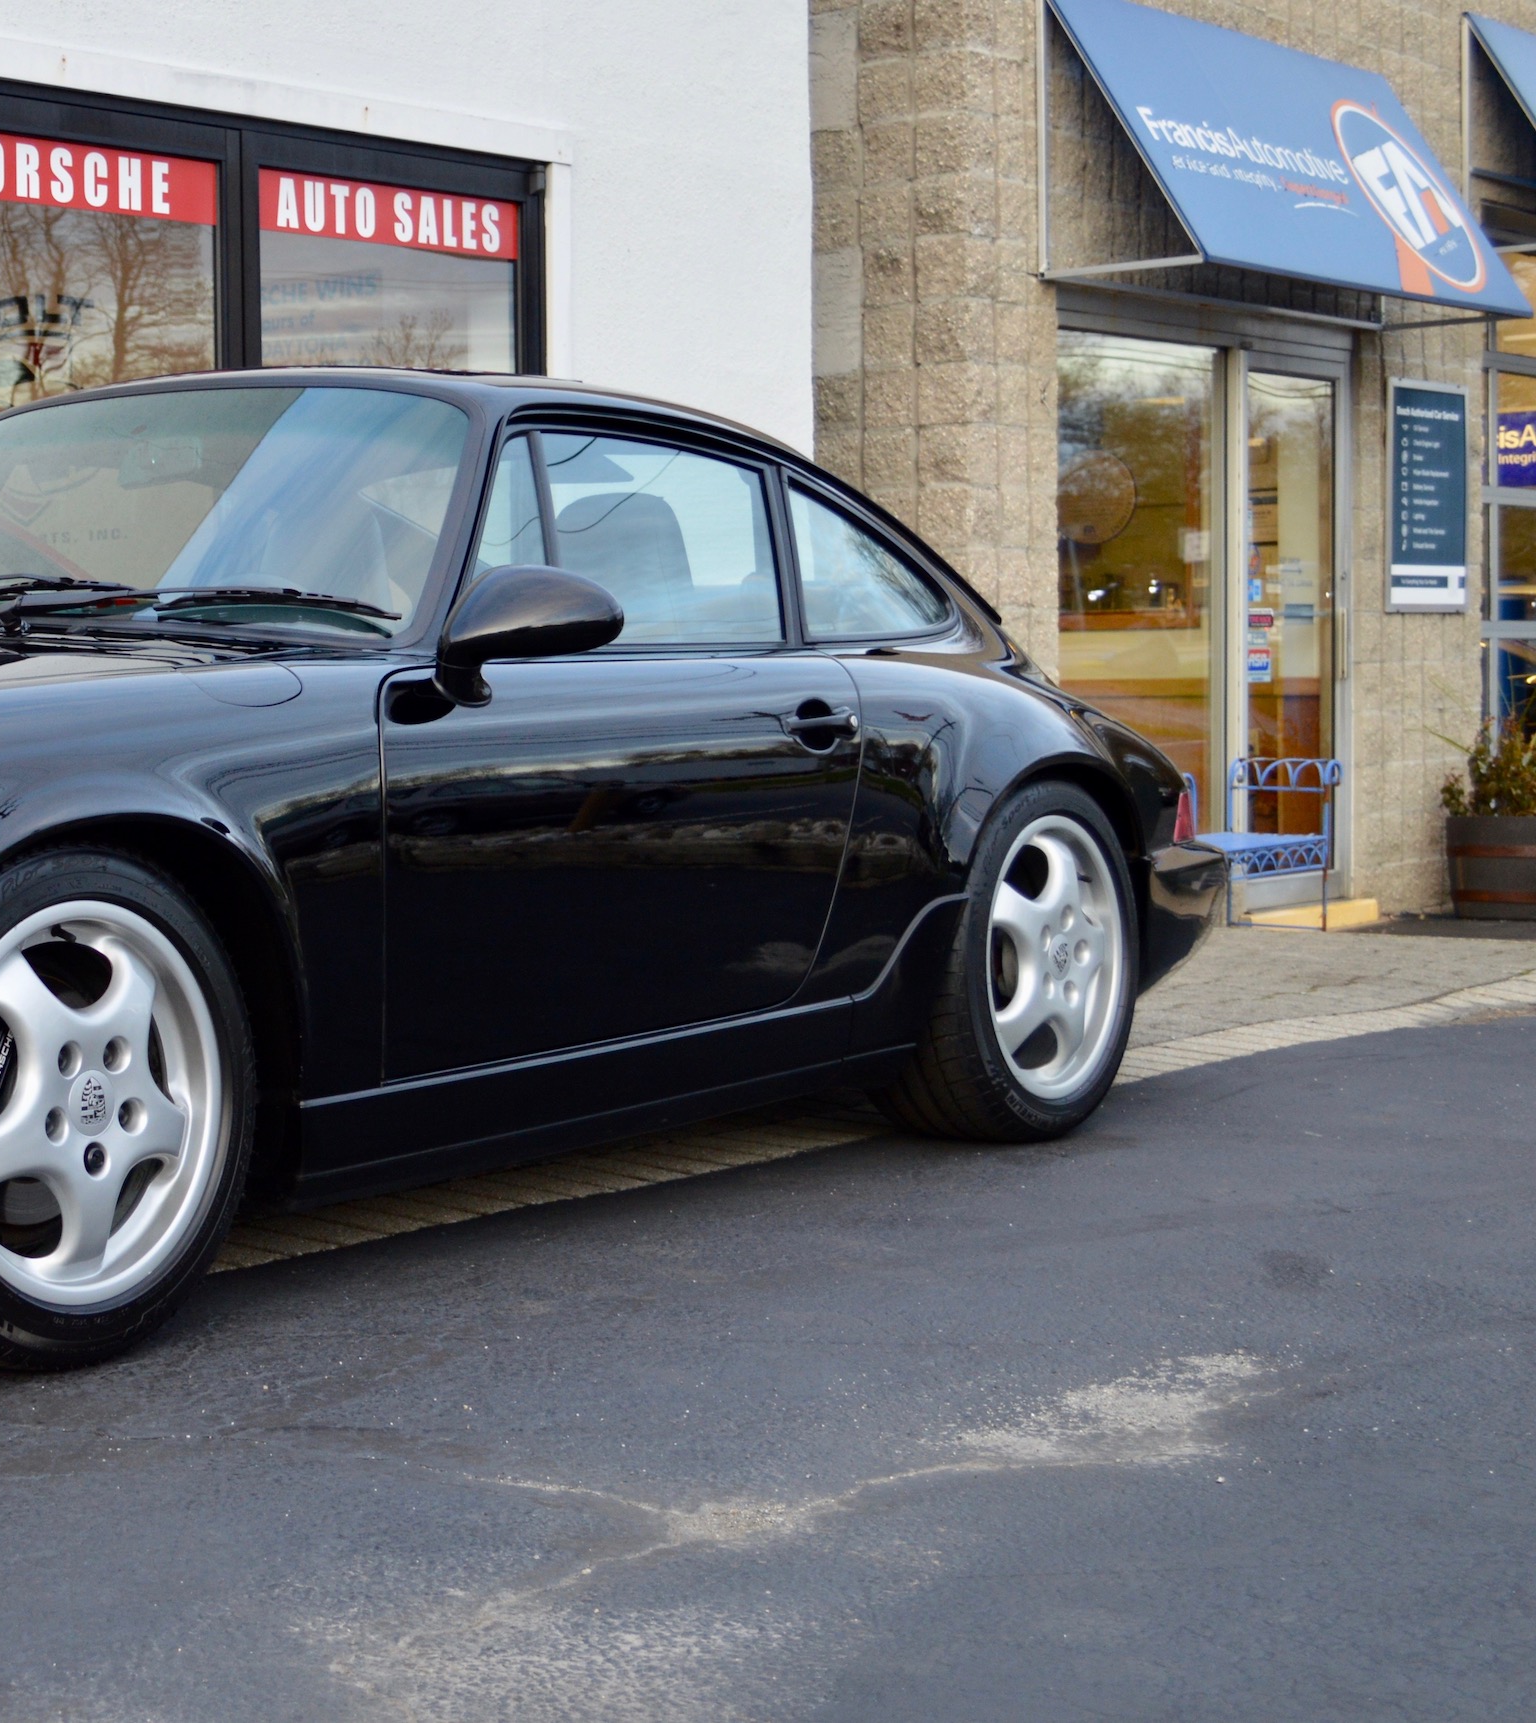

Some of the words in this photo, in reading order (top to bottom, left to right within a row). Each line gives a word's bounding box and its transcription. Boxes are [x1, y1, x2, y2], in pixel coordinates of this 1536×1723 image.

[275, 177, 376, 240] AUTO
[394, 191, 501, 254] SALES
[1496, 424, 1536, 449] isA
